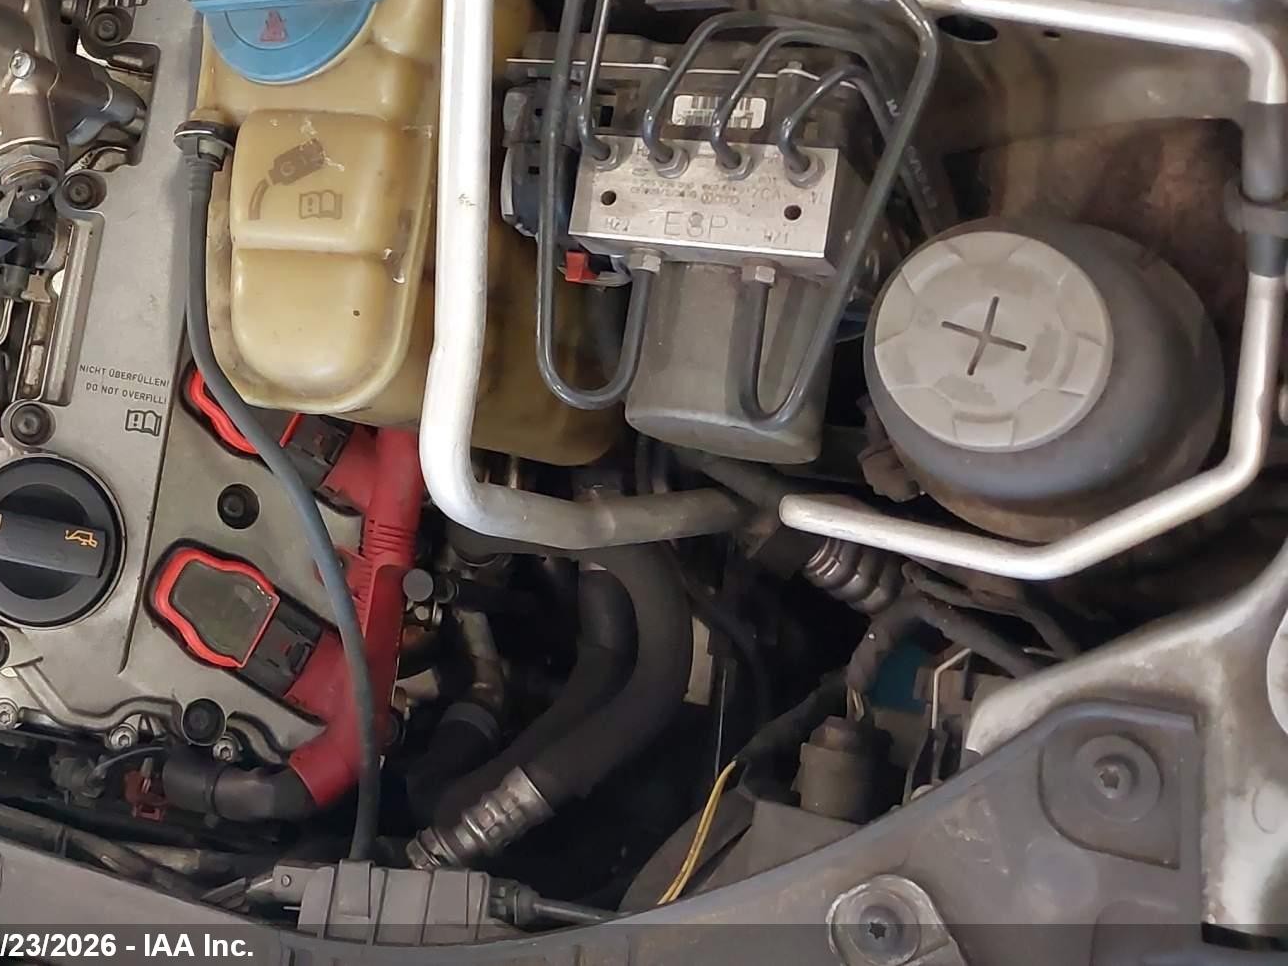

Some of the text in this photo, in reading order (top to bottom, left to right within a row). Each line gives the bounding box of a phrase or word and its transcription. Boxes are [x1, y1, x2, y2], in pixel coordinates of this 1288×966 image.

[79, 364, 106, 375] NICHT
[86, 382, 167, 405] DO NOT OVERFILL!
